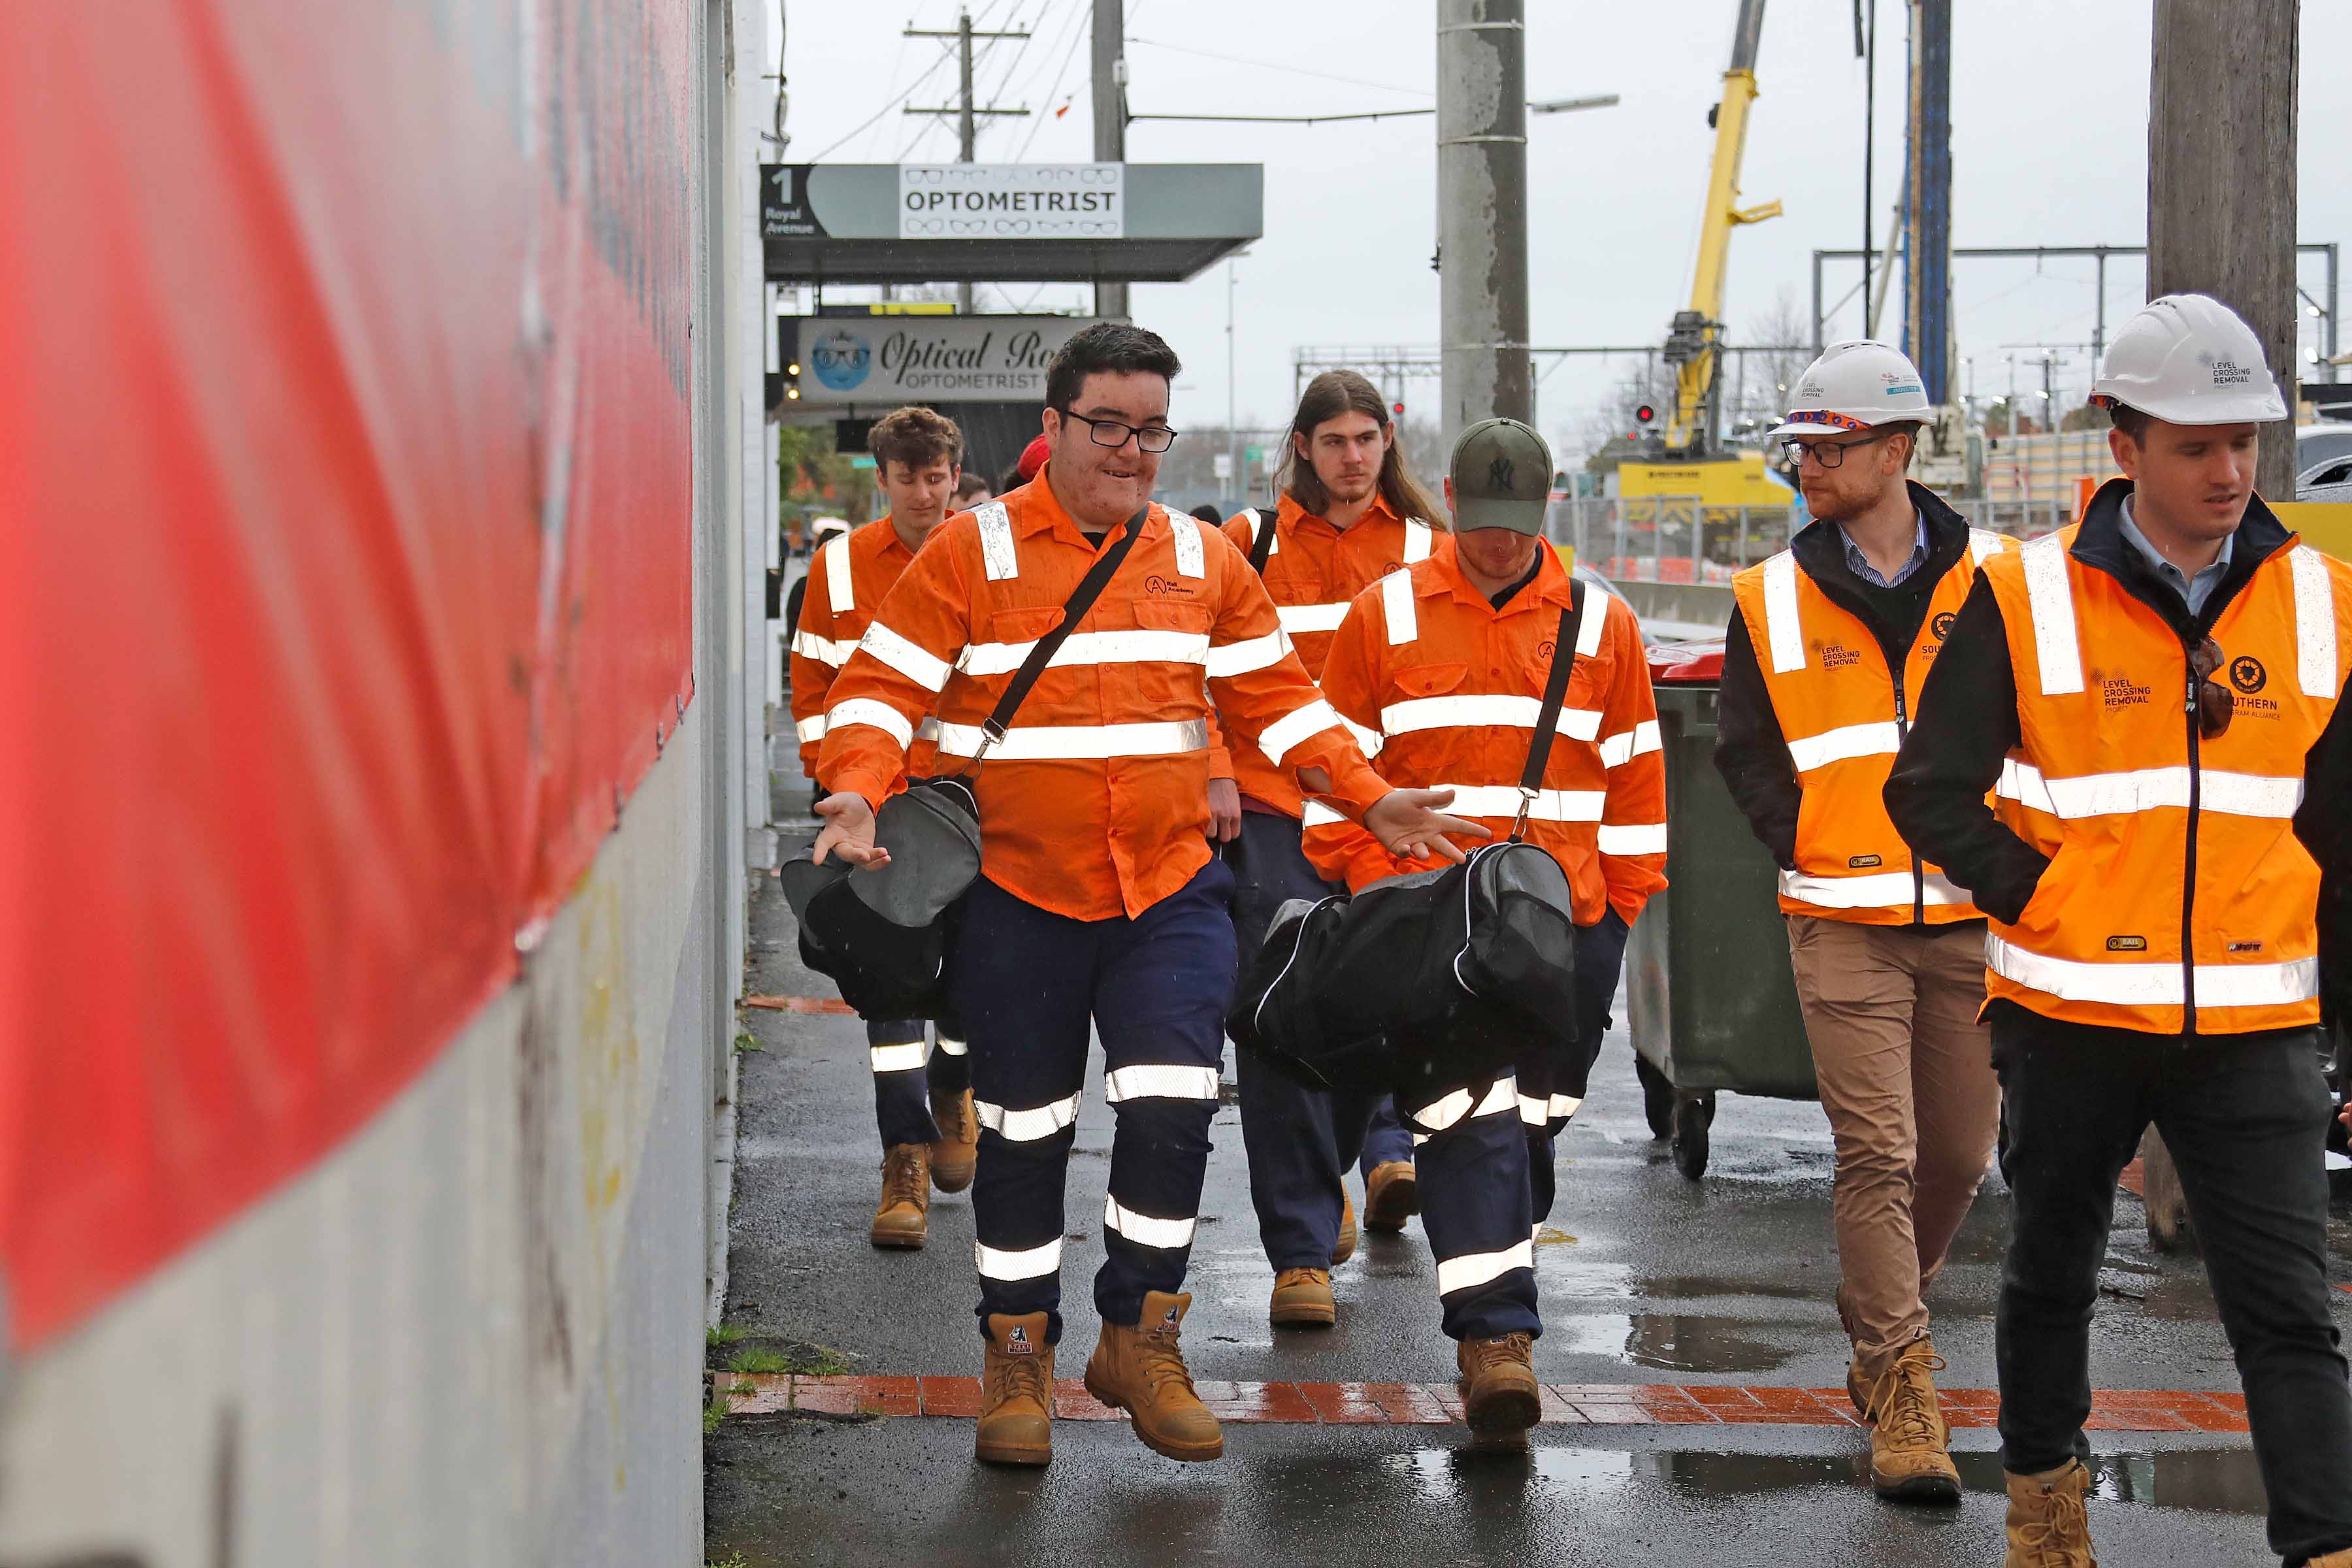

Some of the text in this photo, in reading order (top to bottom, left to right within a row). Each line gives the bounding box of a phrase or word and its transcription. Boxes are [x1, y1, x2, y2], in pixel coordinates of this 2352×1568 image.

[771, 167, 792, 204] 1
[906, 191, 1116, 211] OPTOMETRIST
[765, 205, 801, 223] Royal
[764, 221, 815, 235] Avenue
[881, 330, 1055, 385] Optical Ro
[2212, 361, 2236, 370] LEVEL
[2213, 368, 2251, 377] CROSSING
[906, 373, 1039, 389] OPTOMETRIST
[2213, 376, 2249, 384] REMOVAL
[1822, 645, 1845, 655] LEVEL
[1823, 651, 1860, 661] CROSSING
[1824, 658, 1859, 668] REMOVAL
[2104, 679, 2132, 689] LEVEL
[2104, 687, 2151, 698] CROSSING
[2105, 695, 2149, 706] REMOVAL
[2232, 697, 2278, 710] UTHERN
[2251, 711, 2281, 721] ALLIANCE
